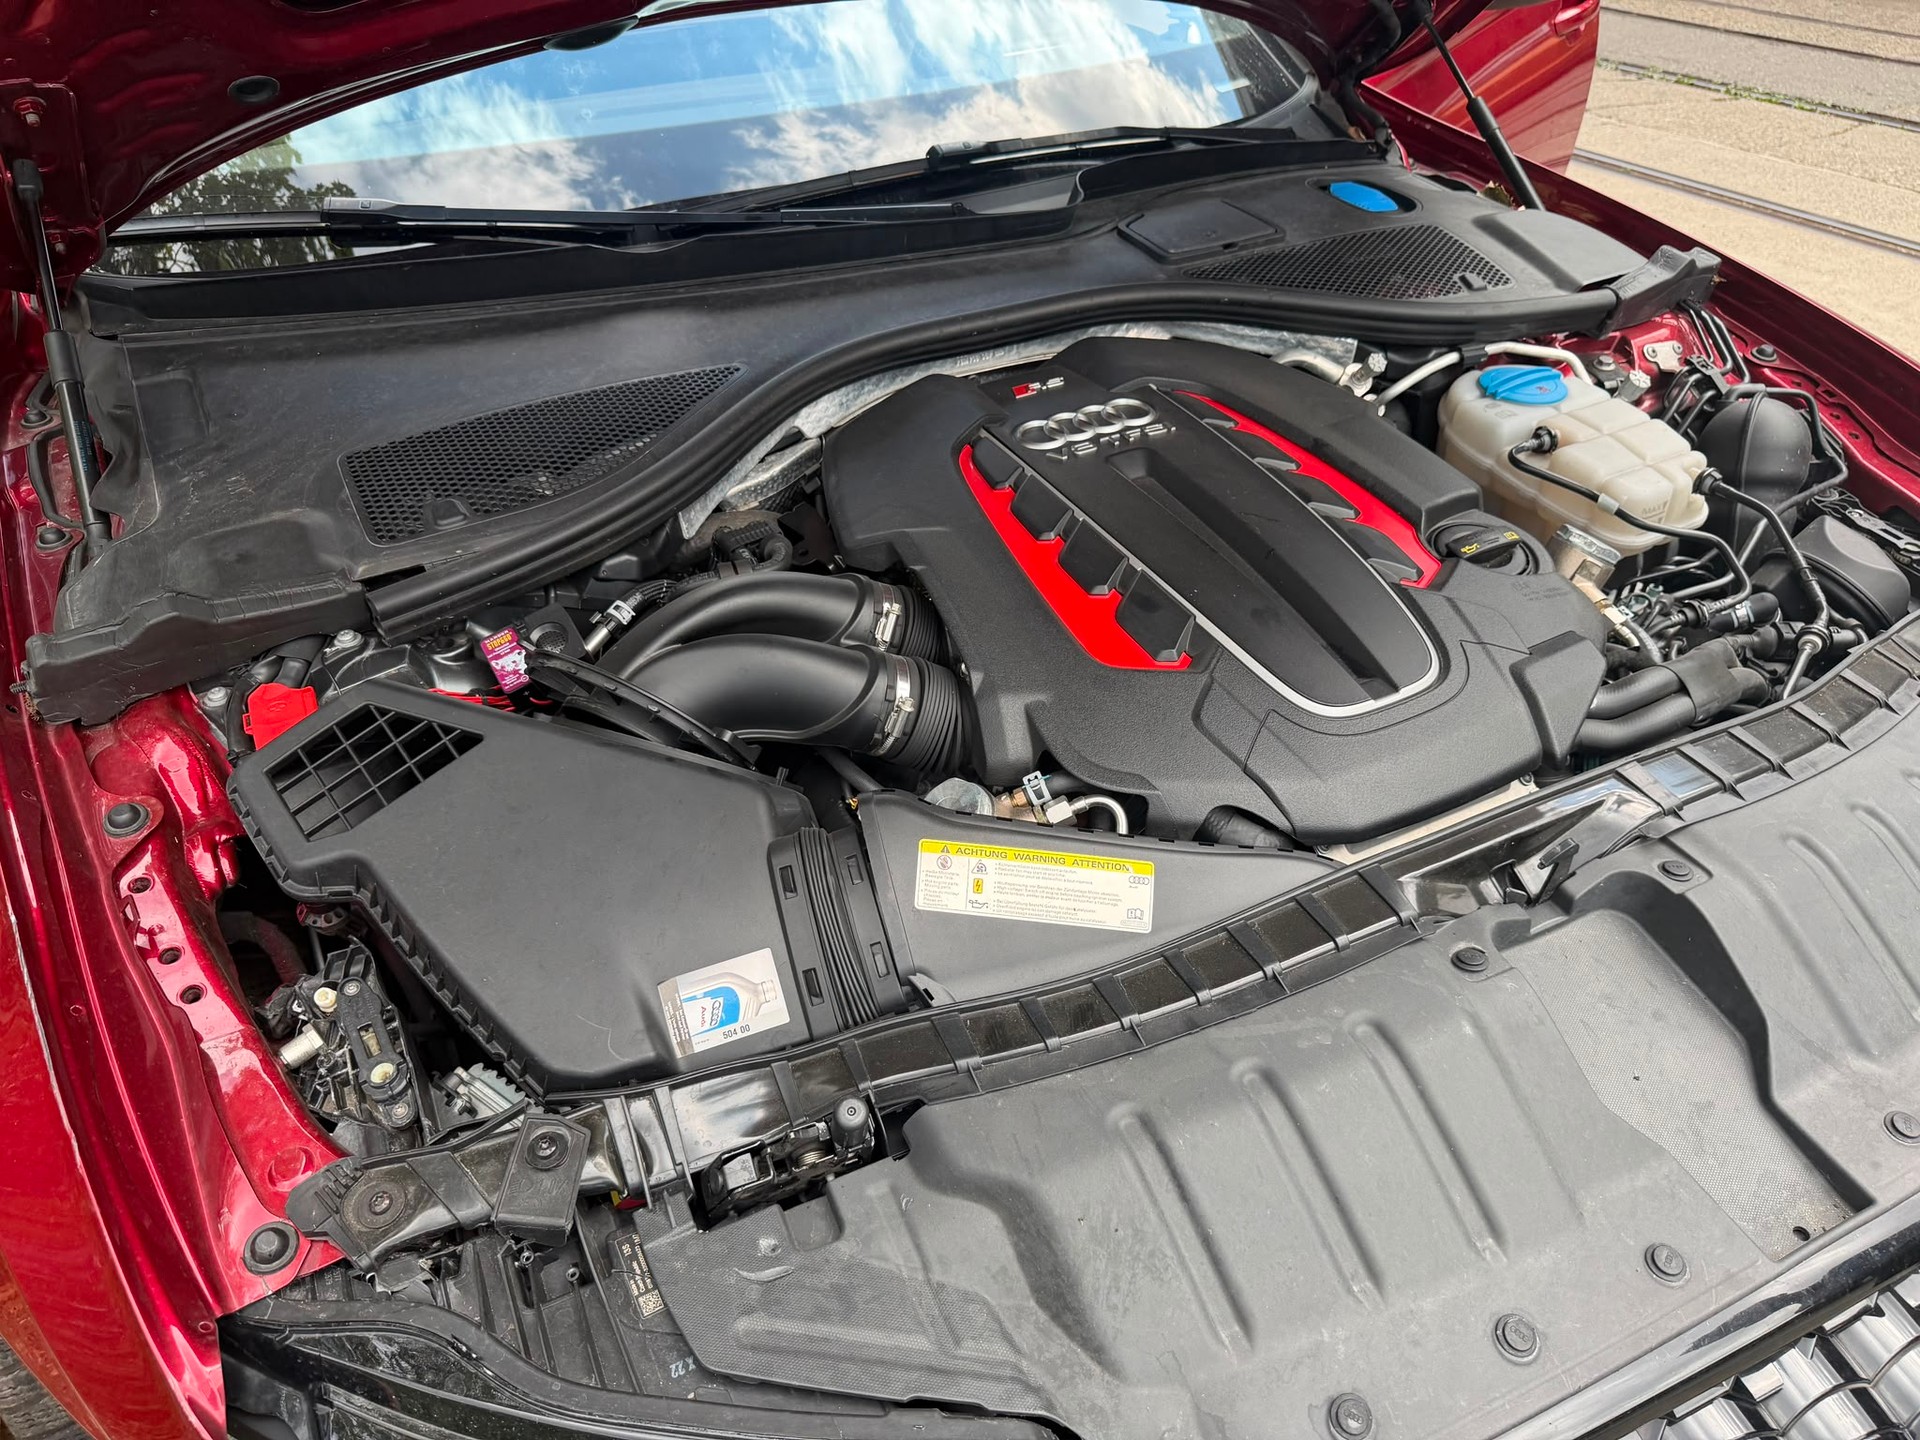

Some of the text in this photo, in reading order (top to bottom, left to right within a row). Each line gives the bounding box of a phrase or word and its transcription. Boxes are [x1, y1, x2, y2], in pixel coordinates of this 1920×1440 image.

[1100, 423, 1177, 447] TFSI
[955, 847, 1008, 859] ACHTUNG
[1013, 853, 1066, 865] WARNING
[1072, 858, 1130, 872] ATTENTION
[722, 1023, 751, 1040] 504 00
